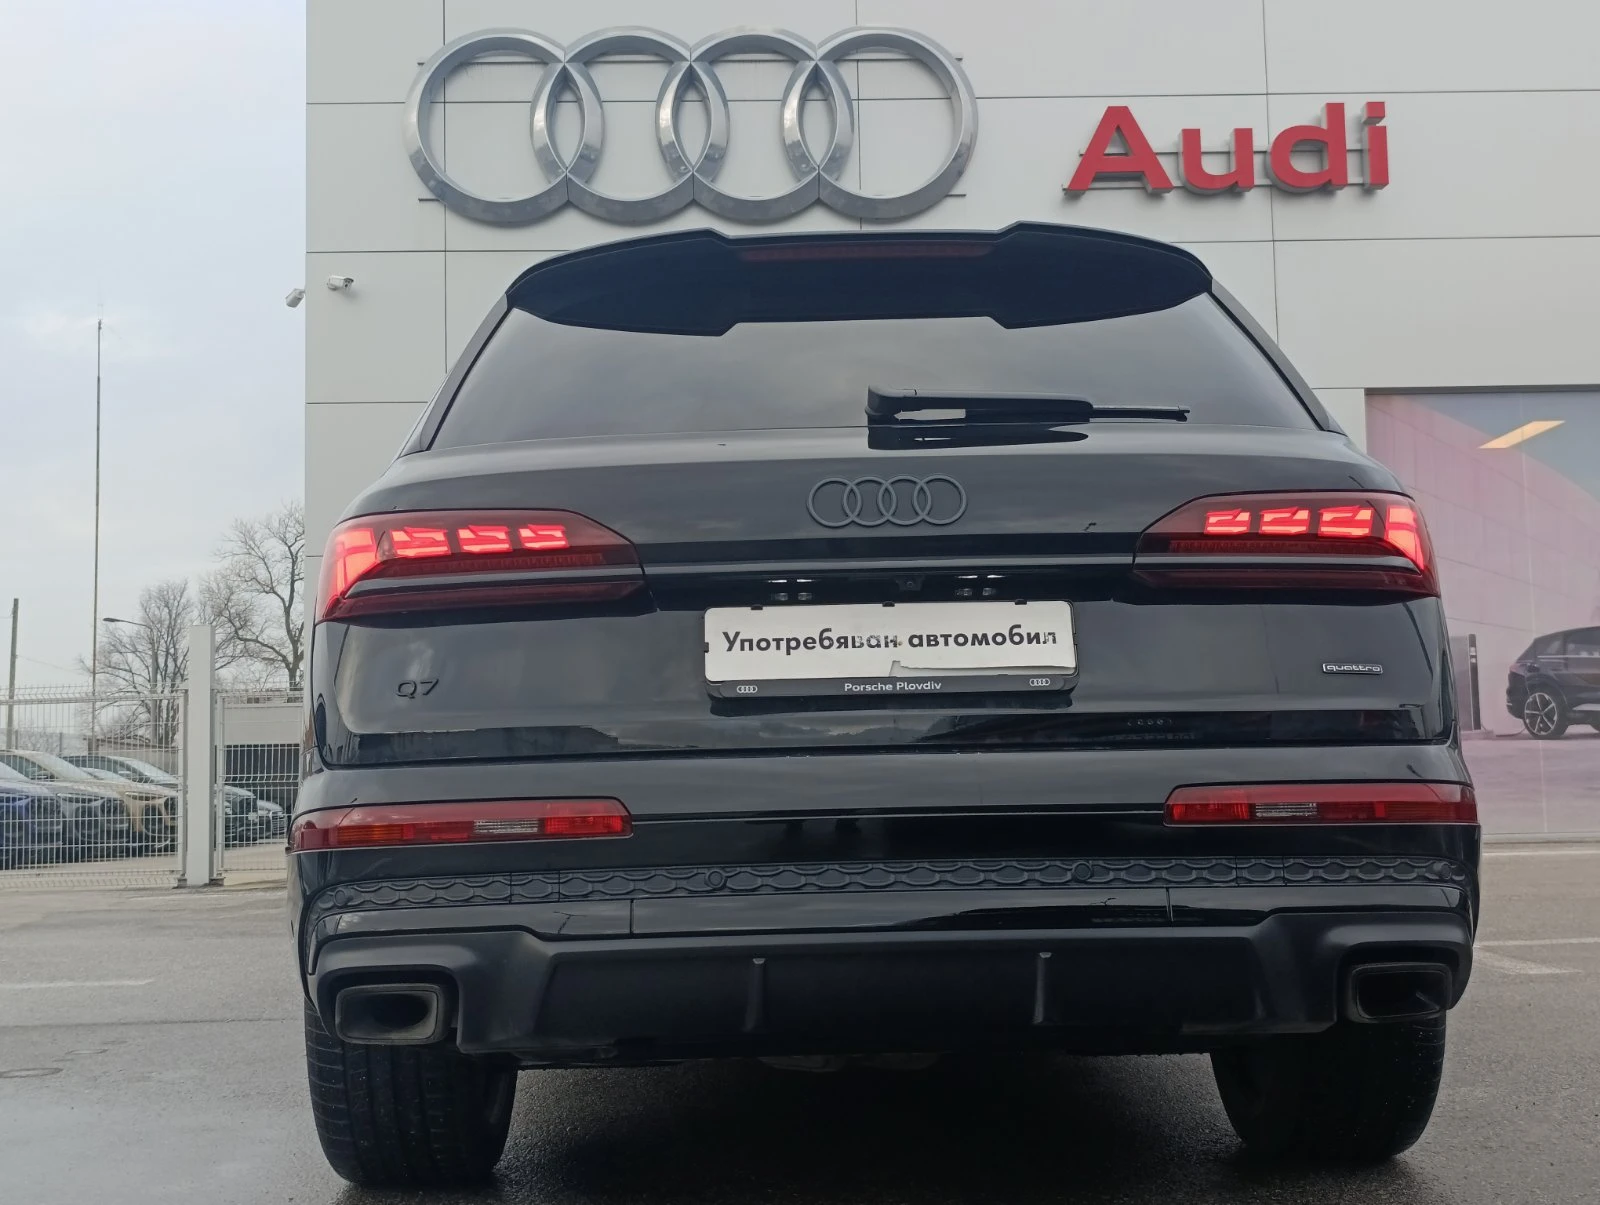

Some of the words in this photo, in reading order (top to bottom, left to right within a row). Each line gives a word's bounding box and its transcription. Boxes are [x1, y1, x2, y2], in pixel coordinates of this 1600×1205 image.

[1063, 101, 1389, 194] Audi
[722, 628, 898, 656] Употребяван
[908, 624, 1057, 648] автомобил
[1325, 664, 1381, 672] quattro
[397, 679, 439, 699] Q7
[844, 682, 893, 692] Porsche
[896, 681, 942, 691] Plovdiv
